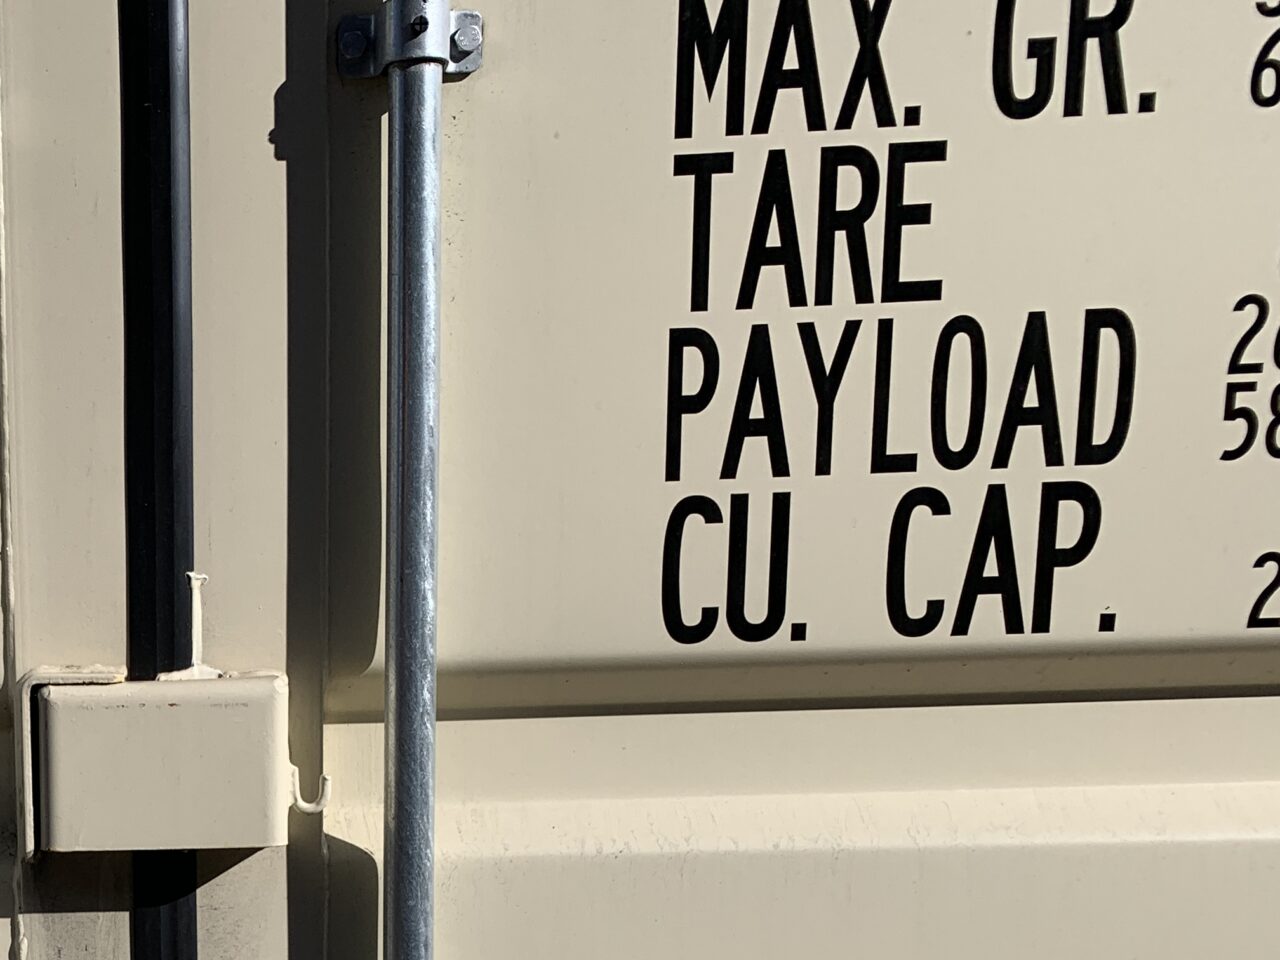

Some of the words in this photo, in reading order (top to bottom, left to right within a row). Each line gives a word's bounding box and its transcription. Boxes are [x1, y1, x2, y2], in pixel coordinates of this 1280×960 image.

[673, 0, 922, 140] MAX.
[992, 0, 1157, 120] GR.
[673, 139, 948, 312] TARE
[664, 307, 1138, 483] PAYLOAD
[660, 491, 808, 645] CU.
[885, 480, 1117, 638] CAP.
